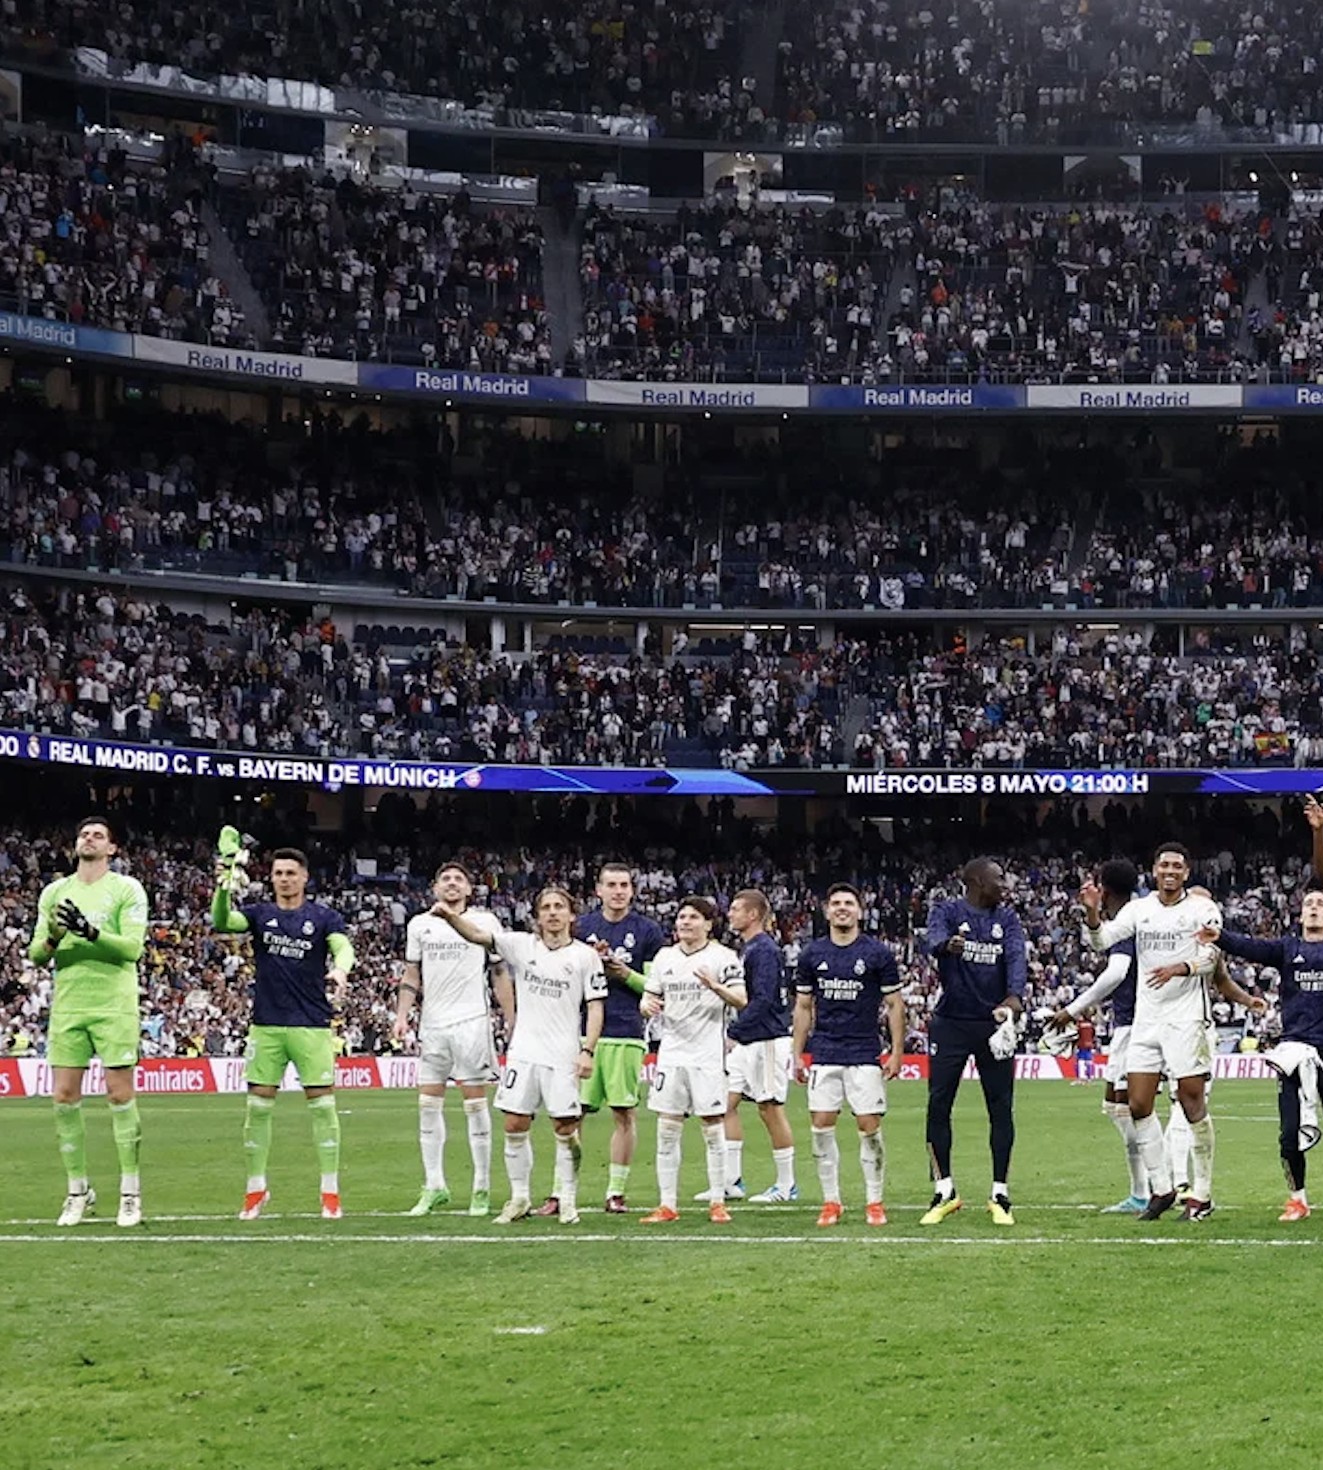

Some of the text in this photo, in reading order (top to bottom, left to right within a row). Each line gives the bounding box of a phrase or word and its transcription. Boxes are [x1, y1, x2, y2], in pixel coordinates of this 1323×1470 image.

[17, 319, 75, 345] Madrid
[188, 350, 303, 378] Real Madrid
[415, 372, 529, 395] Real Madrid
[642, 389, 755, 407] Real Madrid
[865, 388, 972, 405] Real Madrid
[1080, 390, 1190, 406] Real Madrid
[49, 740, 93, 765] REAL
[96, 746, 169, 772] MADRID
[173, 754, 192, 774] C.
[197, 756, 212, 775] F.
[217, 763, 235, 777] vs
[239, 759, 323, 782] BAYERN
[328, 764, 359, 785] DE
[364, 761, 456, 788] MÚNICH
[847, 769, 1149, 793] MIÉRCOLES 8 MAYO 21:00 H
[263, 931, 313, 950] Emirates
[1138, 930, 1183, 941] Emirates
[421, 940, 470, 952] Emirates
[964, 940, 1004, 954] mirates
[524, 969, 571, 990] Emirates
[817, 977, 864, 991] Emirates
[335, 1064, 372, 1087] irates
[1014, 1058, 1040, 1078] TER
[133, 1065, 204, 1092] Emirates
